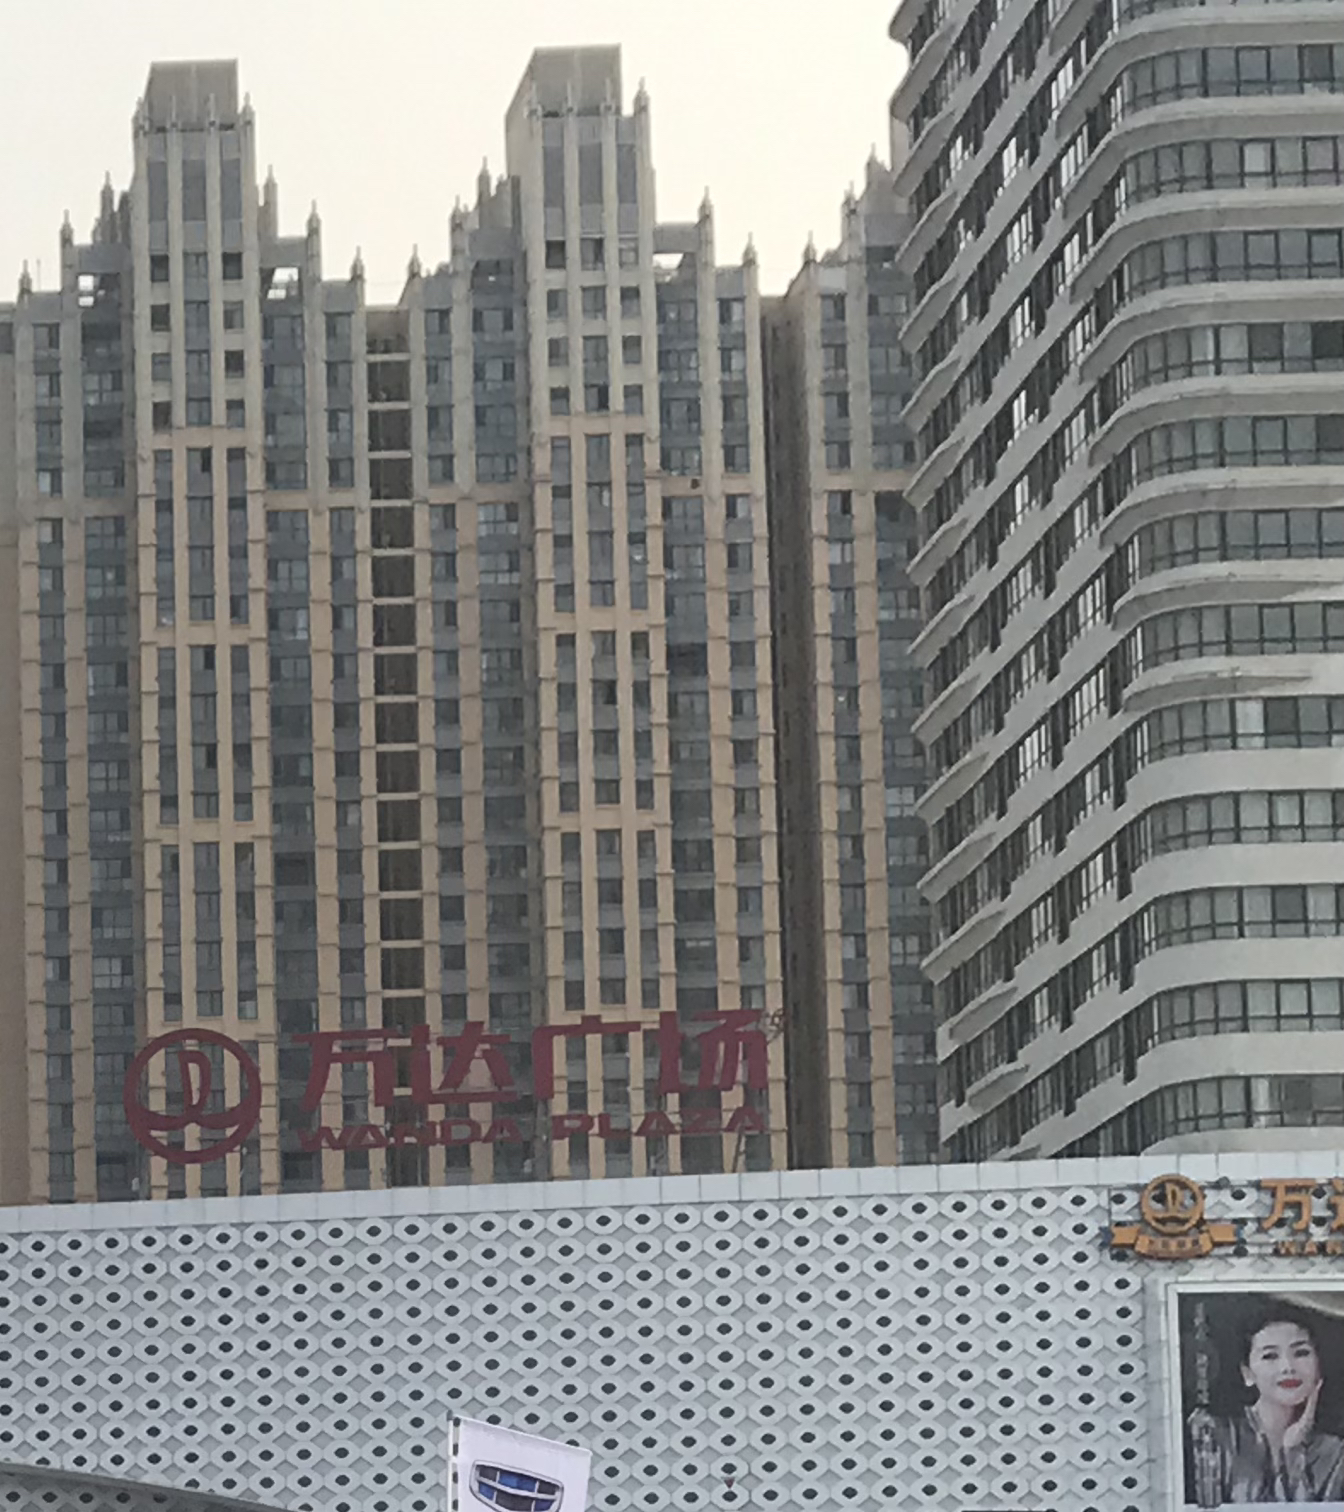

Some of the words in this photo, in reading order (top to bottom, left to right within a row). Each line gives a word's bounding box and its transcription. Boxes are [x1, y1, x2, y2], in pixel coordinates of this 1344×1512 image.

[293, 1009, 769, 1114] 万达广场
[296, 1116, 524, 1151] WANDA
[551, 1105, 769, 1140] PLAZA
